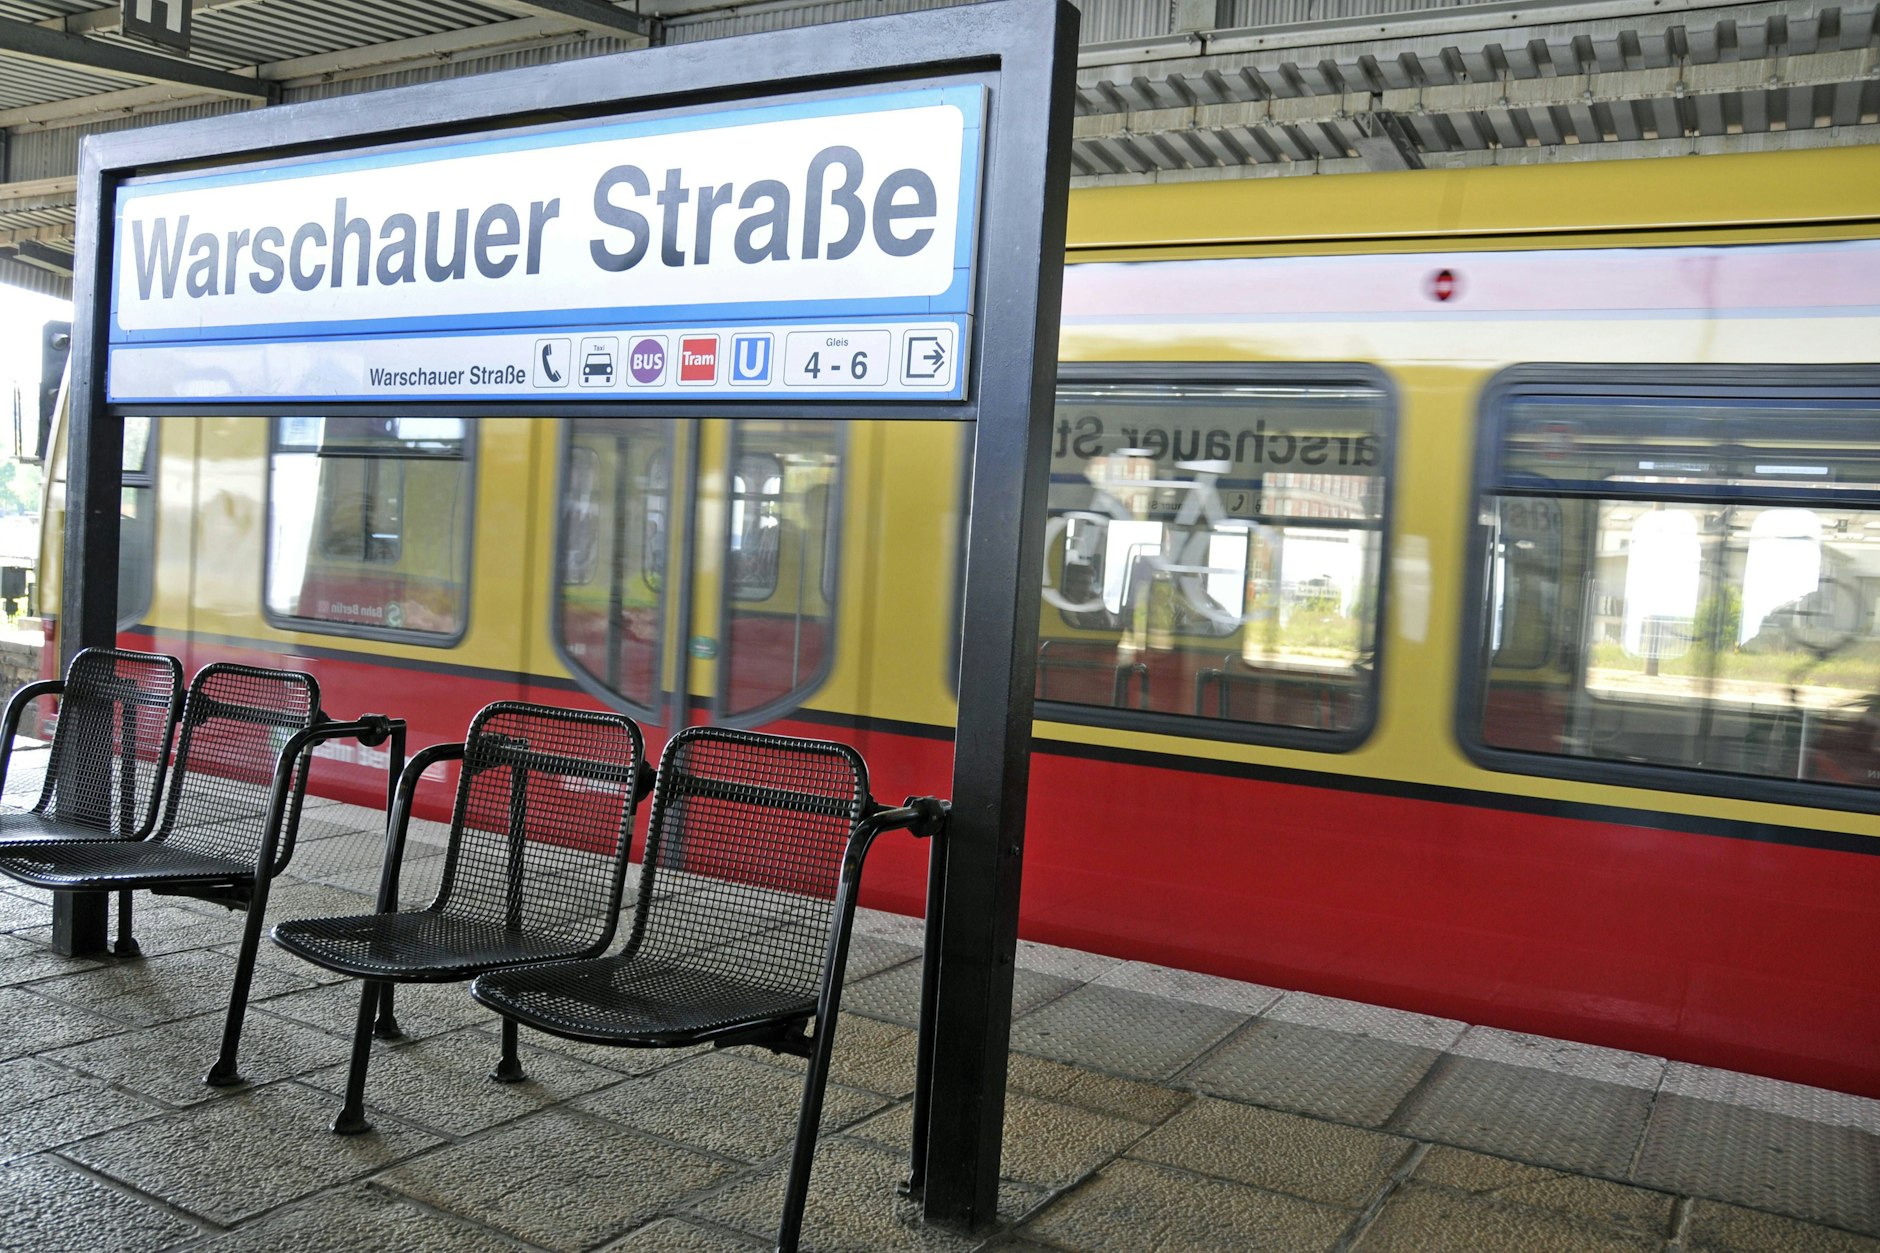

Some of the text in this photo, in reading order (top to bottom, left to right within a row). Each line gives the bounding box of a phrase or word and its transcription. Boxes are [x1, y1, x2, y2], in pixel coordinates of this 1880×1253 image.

[131, 145, 937, 300] Warschauer Straße
[826, 337, 848, 347] Gleis
[633, 353, 662, 370] BUS
[683, 351, 714, 366] Tram
[739, 341, 764, 378] U
[804, 351, 820, 379] 4
[851, 351, 868, 380] 6
[370, 364, 526, 386] Warschauer Straße
